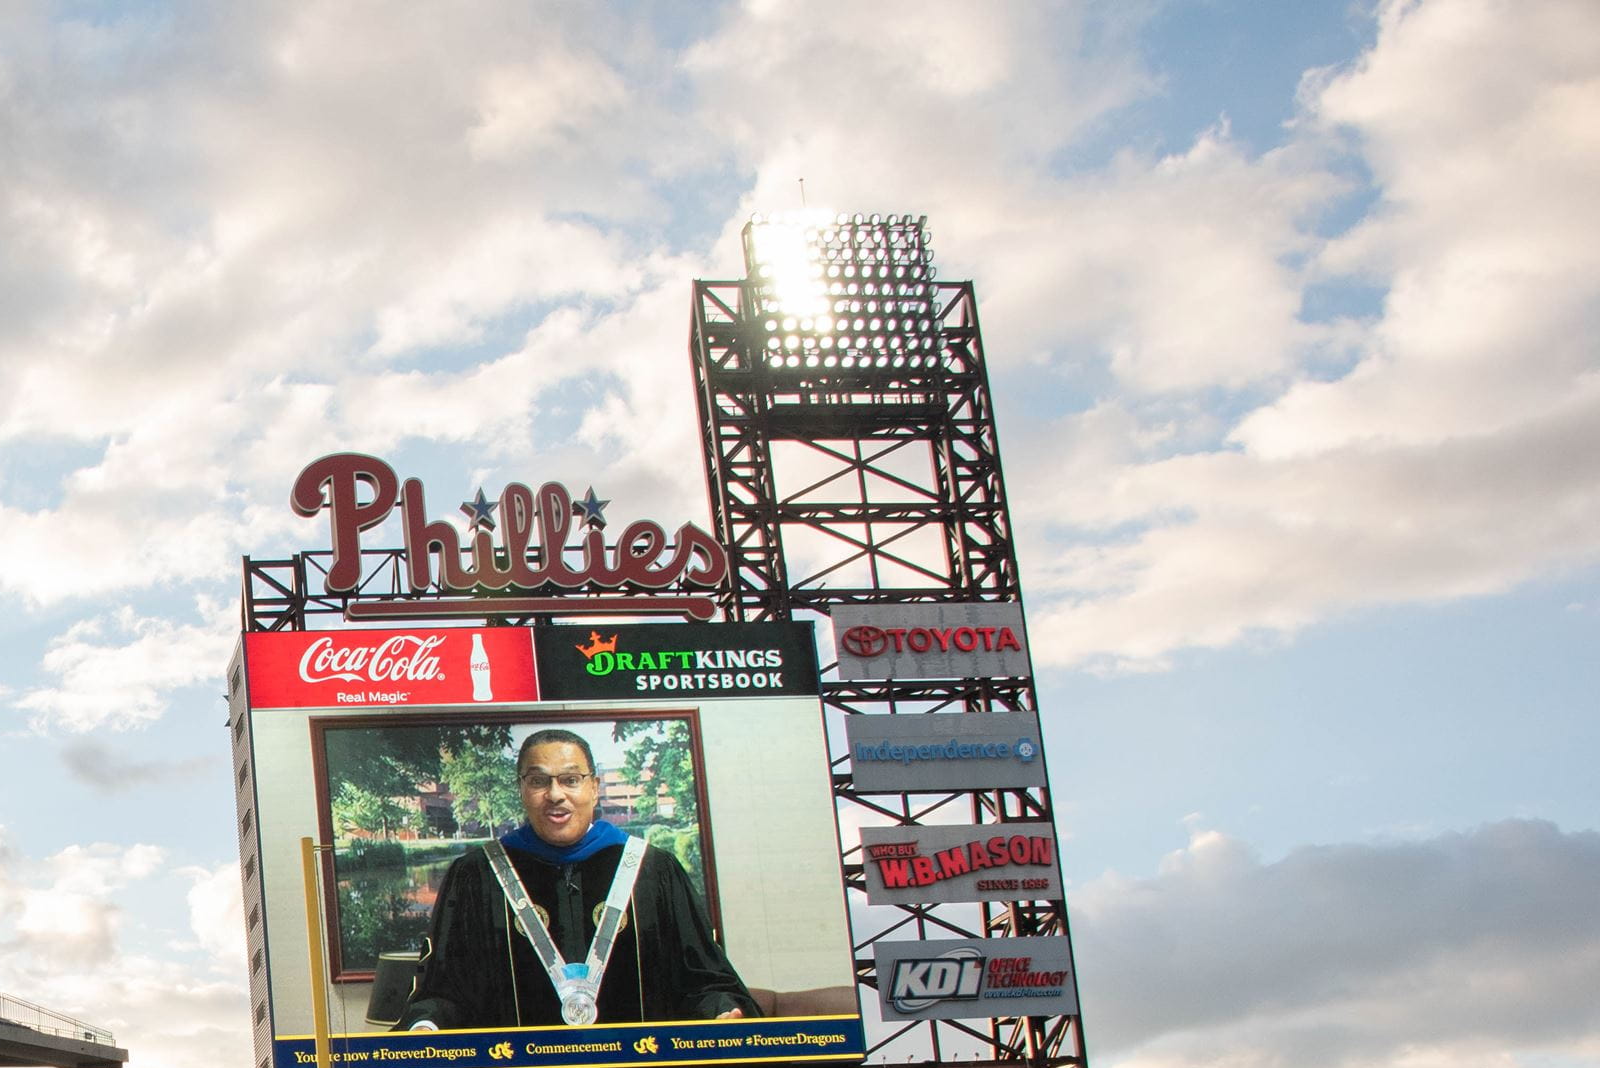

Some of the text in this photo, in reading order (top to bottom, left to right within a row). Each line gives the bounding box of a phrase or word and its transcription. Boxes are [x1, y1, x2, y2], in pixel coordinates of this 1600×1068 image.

[290, 452, 728, 593] Phillies
[887, 627, 1021, 652] TOYOTA
[299, 634, 447, 684] Coca-Cola
[586, 649, 783, 676] DRAFTKINGS
[636, 672, 784, 691] SPORTSBOOK
[337, 691, 407, 704] Real Magic
[856, 739, 1009, 765] Independence
[872, 844, 896, 857] WHO
[977, 879, 1019, 891] SINCE
[988, 957, 1032, 973] OFFICE
[896, 958, 983, 998] KDI
[987, 971, 1068, 989] TECHNOLOGY
[343, 1052, 369, 1062] now
[372, 1045, 477, 1061] #ForeverDragons
[526, 1040, 622, 1054] Commencement
[671, 1036, 694, 1049] You
[696, 1038, 716, 1048] are
[718, 1037, 743, 1048] now
[746, 1033, 846, 1047] #ForeverDragons
